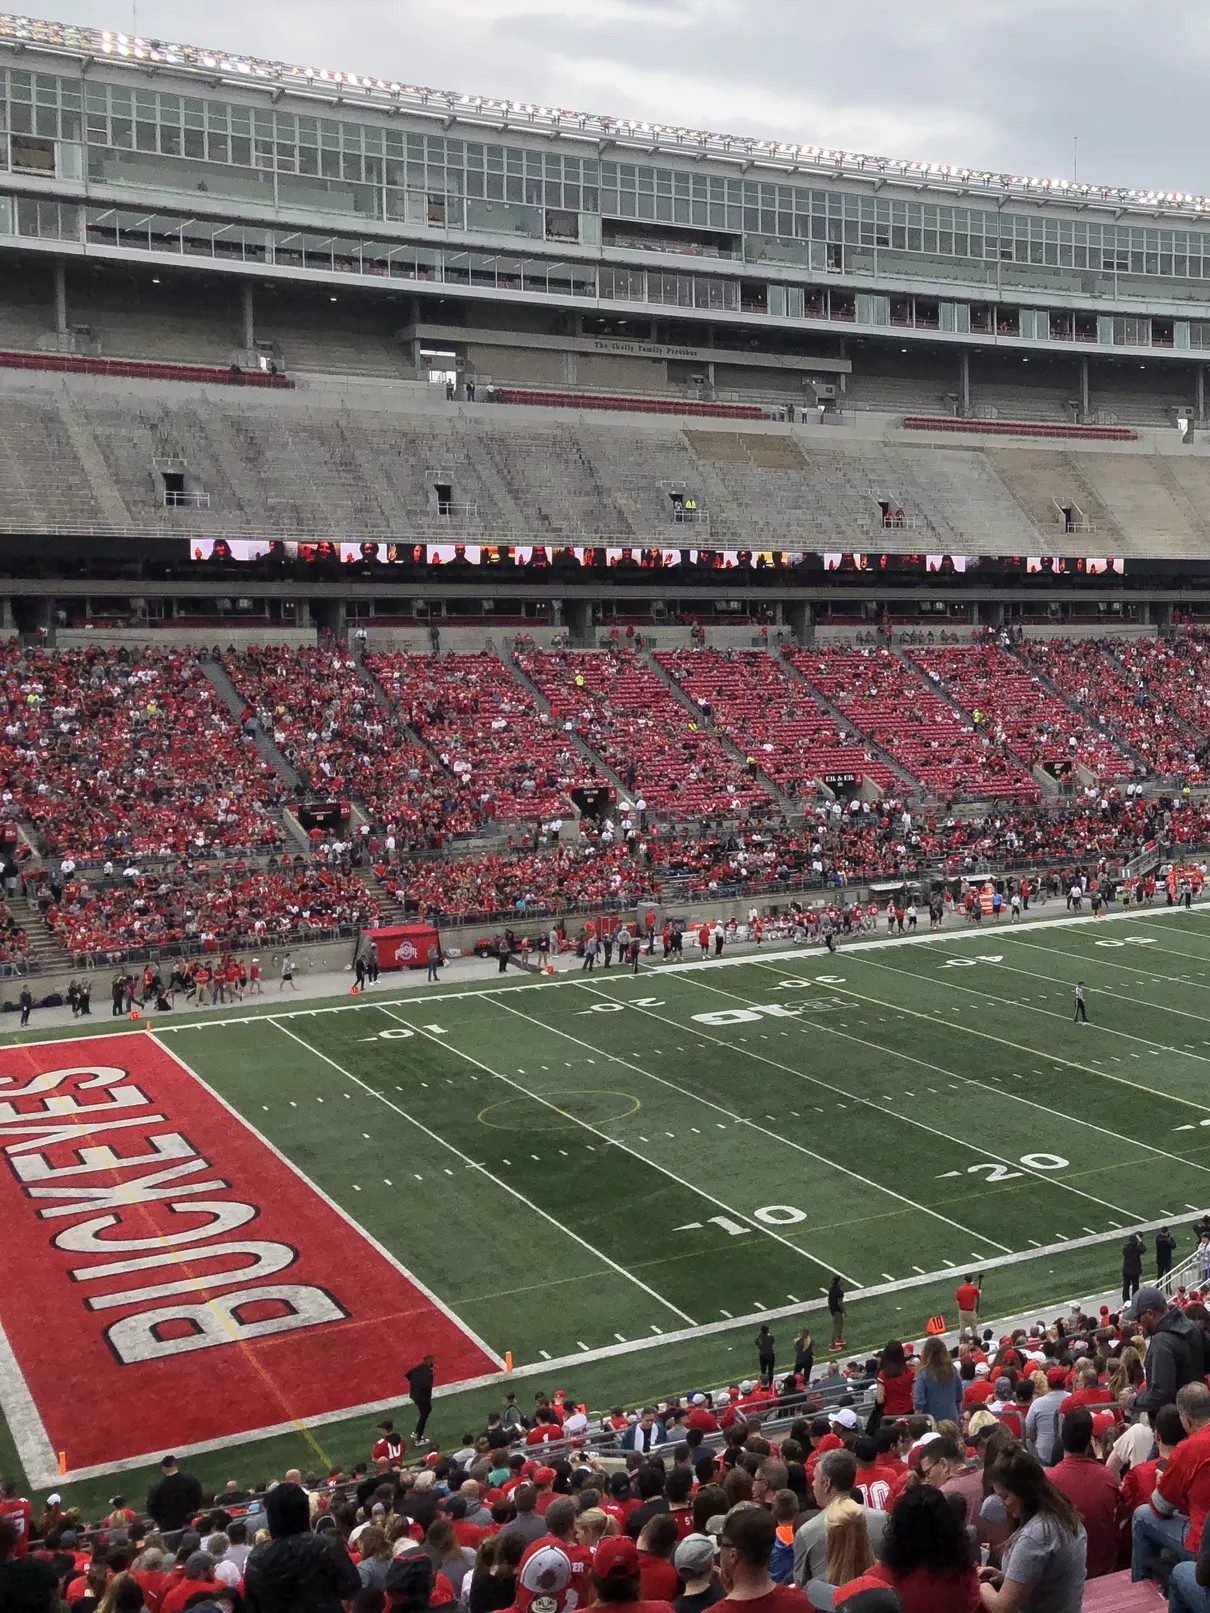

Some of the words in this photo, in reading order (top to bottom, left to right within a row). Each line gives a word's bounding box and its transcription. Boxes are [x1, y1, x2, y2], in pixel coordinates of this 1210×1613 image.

[594, 341, 608, 349] The
[638, 345, 662, 356] Family
[1121, 867, 1131, 878] 11
[1095, 936, 1158, 947] 50
[946, 955, 1004, 966] 40
[778, 975, 847, 988] 30
[590, 997, 666, 1013] 20
[378, 1023, 449, 1039] 10
[967, 1153, 1070, 1182] 20
[0, 1066, 352, 1365] BUCKEYES
[706, 1205, 807, 1235] 10
[932, 1317, 944, 1331] 10
[387, 1443, 401, 1457] 10
